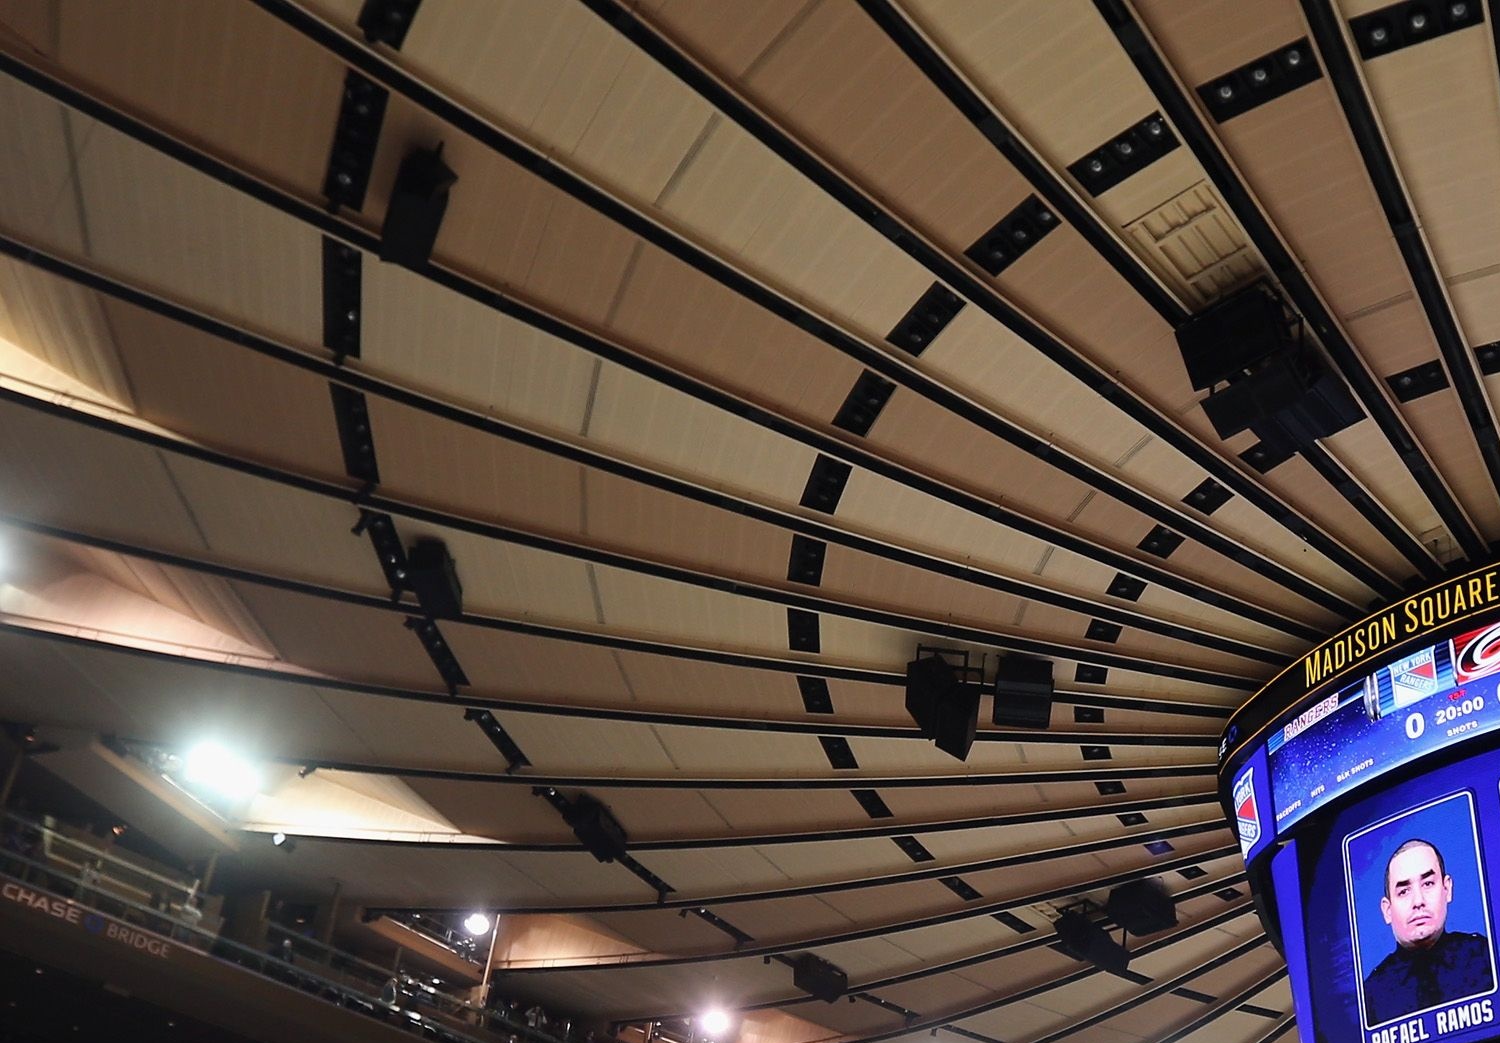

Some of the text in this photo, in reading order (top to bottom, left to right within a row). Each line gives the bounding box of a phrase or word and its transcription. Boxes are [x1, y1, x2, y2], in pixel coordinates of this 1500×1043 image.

[1304, 612, 1397, 688] MADISON
[1404, 574, 1500, 633] SQUARE
[1411, 652, 1431, 667] YORK
[1284, 692, 1339, 740] RANGERS
[1435, 696, 1484, 725] 20:00
[1405, 712, 1425, 739] 0
[1446, 721, 1478, 737] SHOTS
[1350, 758, 1374, 777] SHOTS
[1310, 784, 1325, 799] HITS
[1276, 799, 1302, 822] FACEOFFS
[2, 883, 171, 958] CHASE BRIDGE
[1436, 999, 1494, 1035] RAMOS
